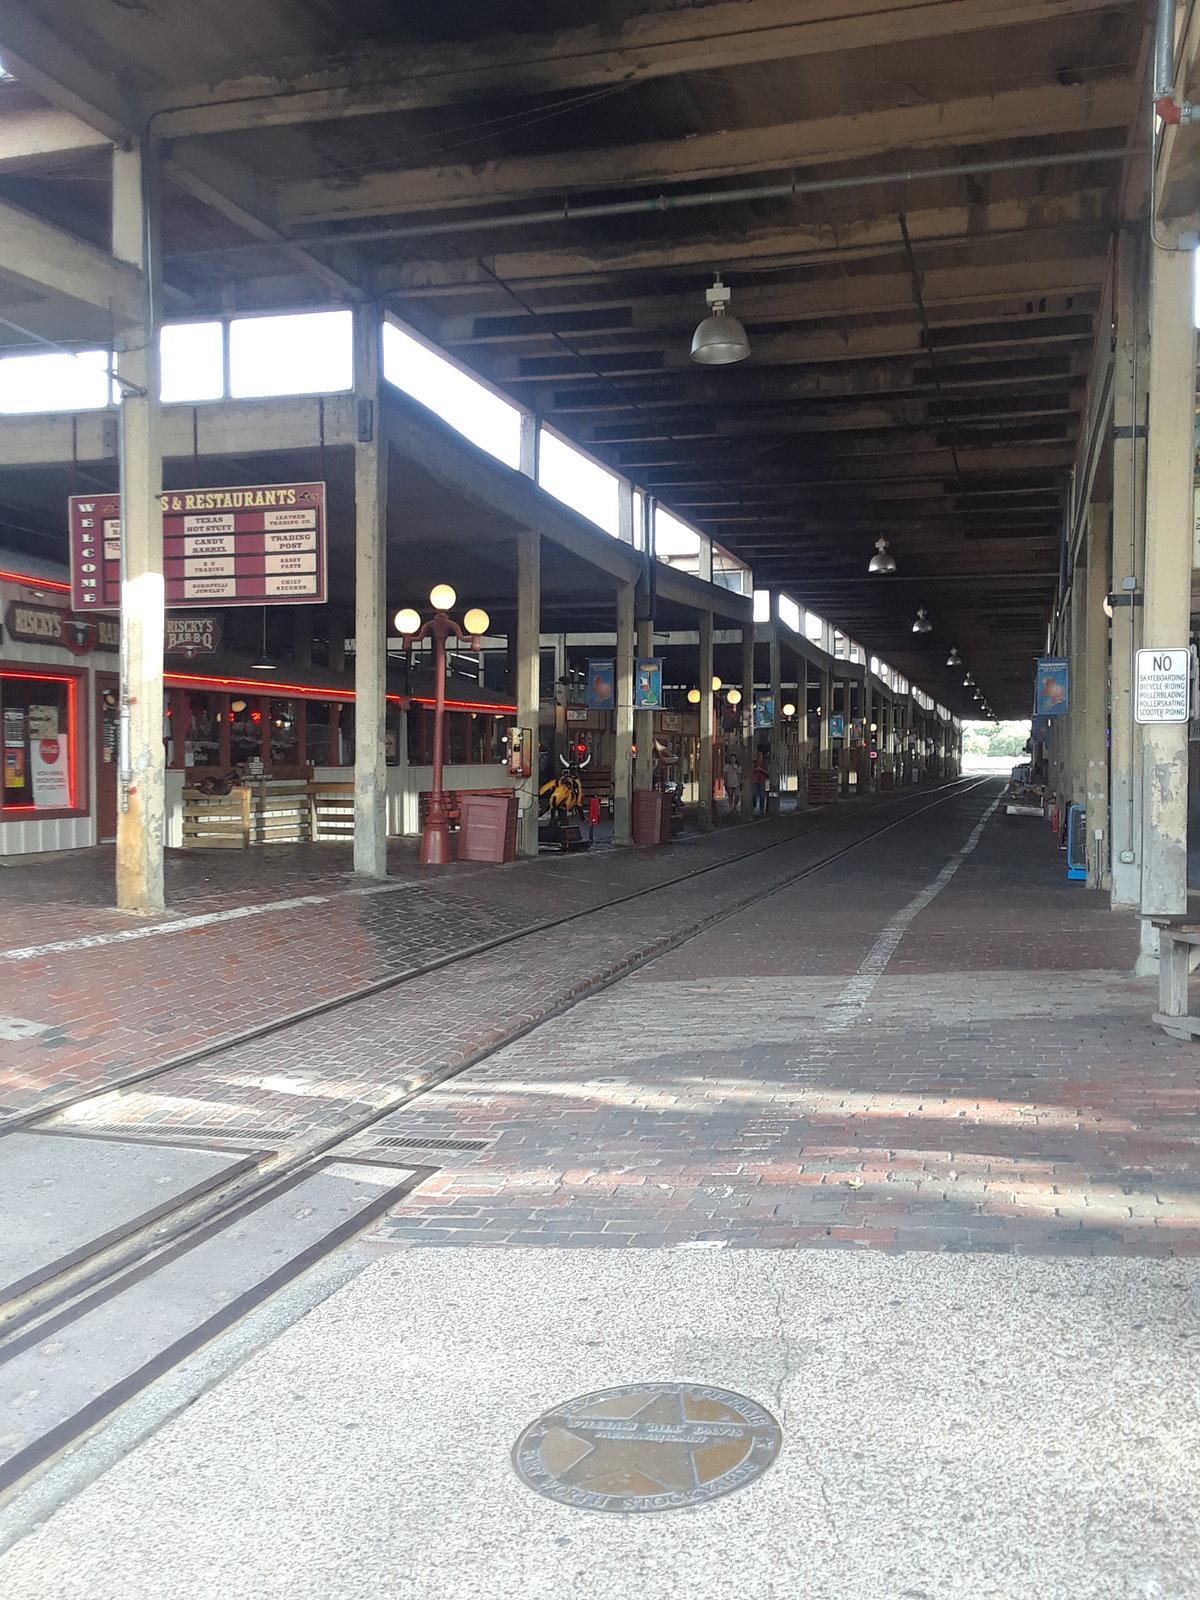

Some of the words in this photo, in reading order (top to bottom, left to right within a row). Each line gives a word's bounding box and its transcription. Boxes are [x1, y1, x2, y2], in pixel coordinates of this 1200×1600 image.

[172, 496, 182, 511] &
[185, 488, 296, 510] RESTAURANTS
[195, 516, 224, 524] TEXAS
[206, 524, 233, 532] STUFF
[194, 538, 225, 546] CANDY
[270, 534, 311, 542] TRADING
[192, 546, 228, 554] BARREL
[279, 542, 303, 550] POST
[78, 503, 97, 603] WELCOME
[166, 619, 213, 633] RISCKY'S
[1153, 656, 1172, 671] NO
[1140, 674, 1185, 682] SKATEBOARDING
[1140, 691, 1185, 699] ROLLERBLADING
[1140, 700, 1185, 708] ROLLERSKATING
[1140, 709, 1164, 717] SCOOTER
[622, 1463, 761, 1509] STOCKYARDS
